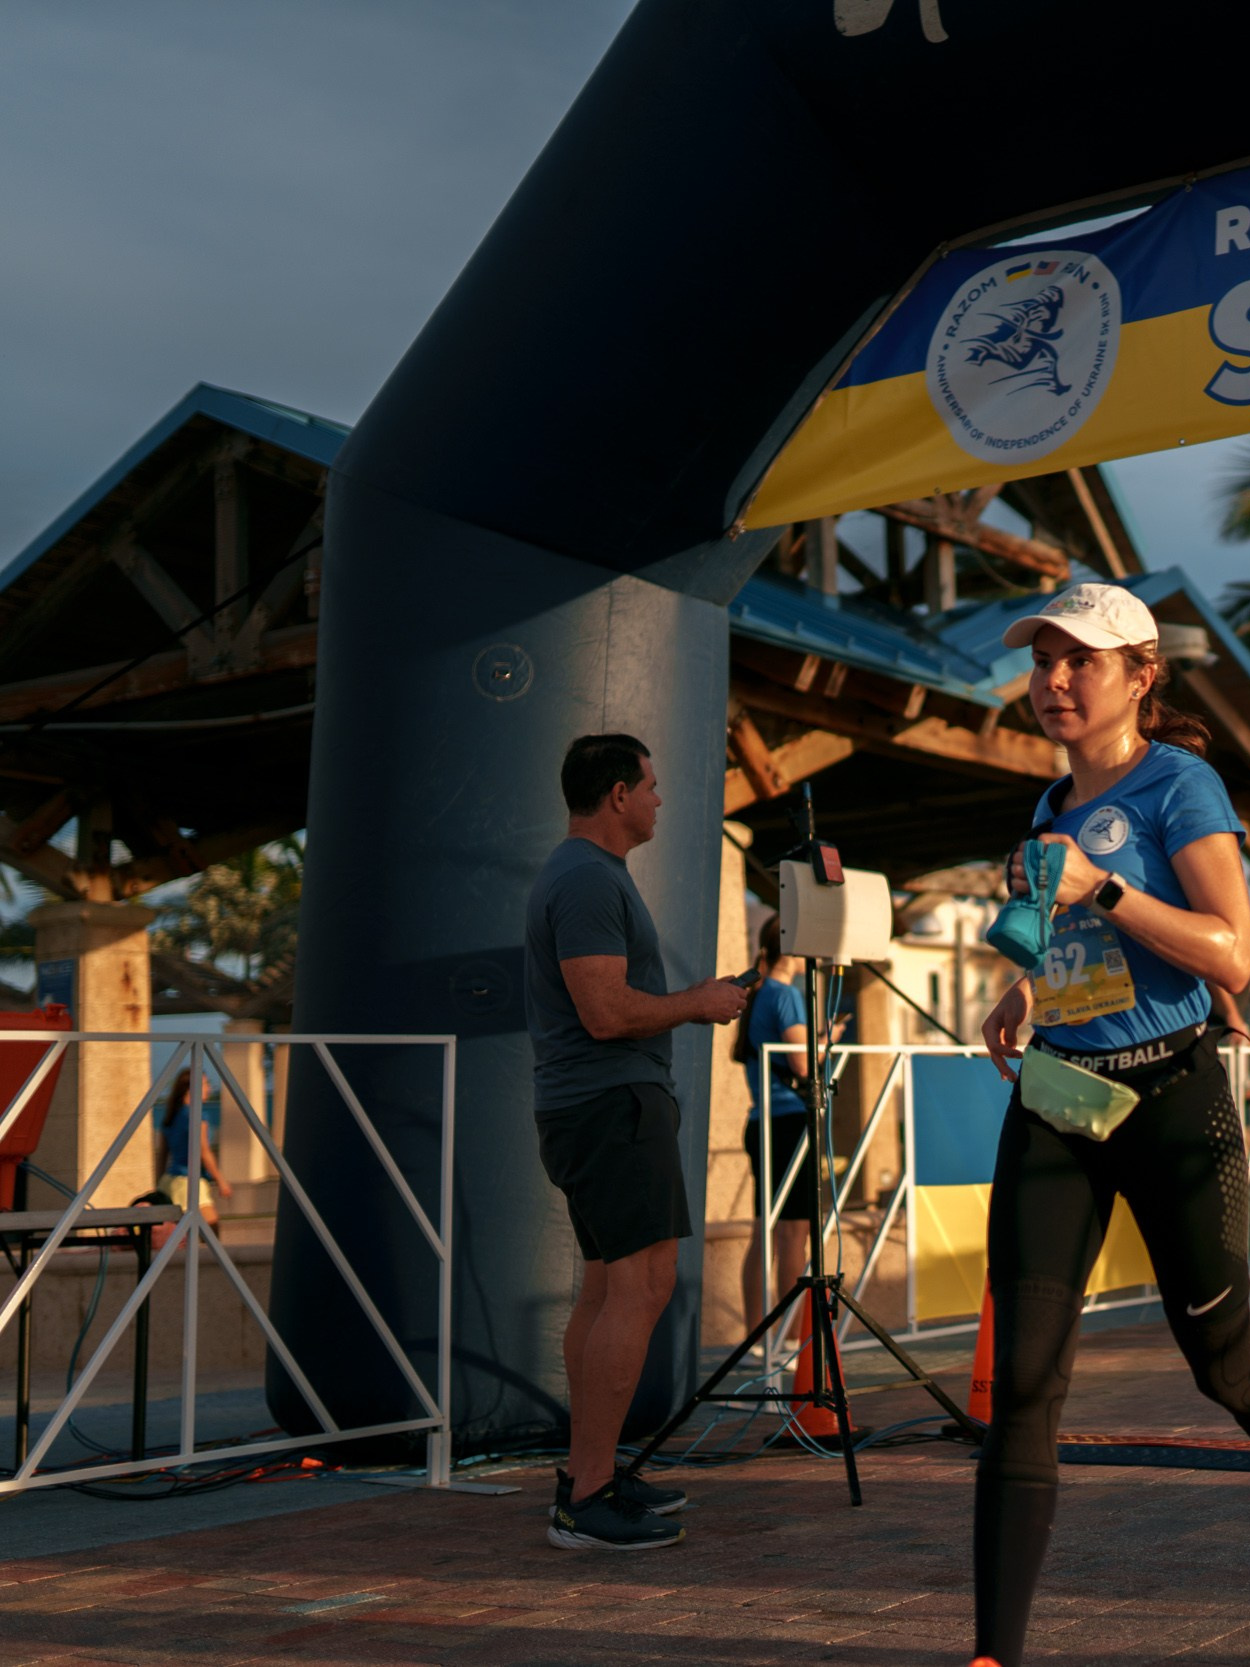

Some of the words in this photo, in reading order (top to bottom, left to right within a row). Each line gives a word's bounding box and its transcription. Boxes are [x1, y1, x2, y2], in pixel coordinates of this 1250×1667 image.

[945, 277, 998, 338] RAZOM
[970, 428, 984, 441] OF
[985, 416, 1068, 450] INDEPENDENCE
[1068, 399, 1083, 417] OF
[1082, 339, 1107, 397] UKRAINE
[1099, 292, 1110, 318] RUN
[1079, 918, 1102, 930] RUN
[1044, 942, 1091, 990] 62
[1070, 1041, 1174, 1072] SOFTBALL
